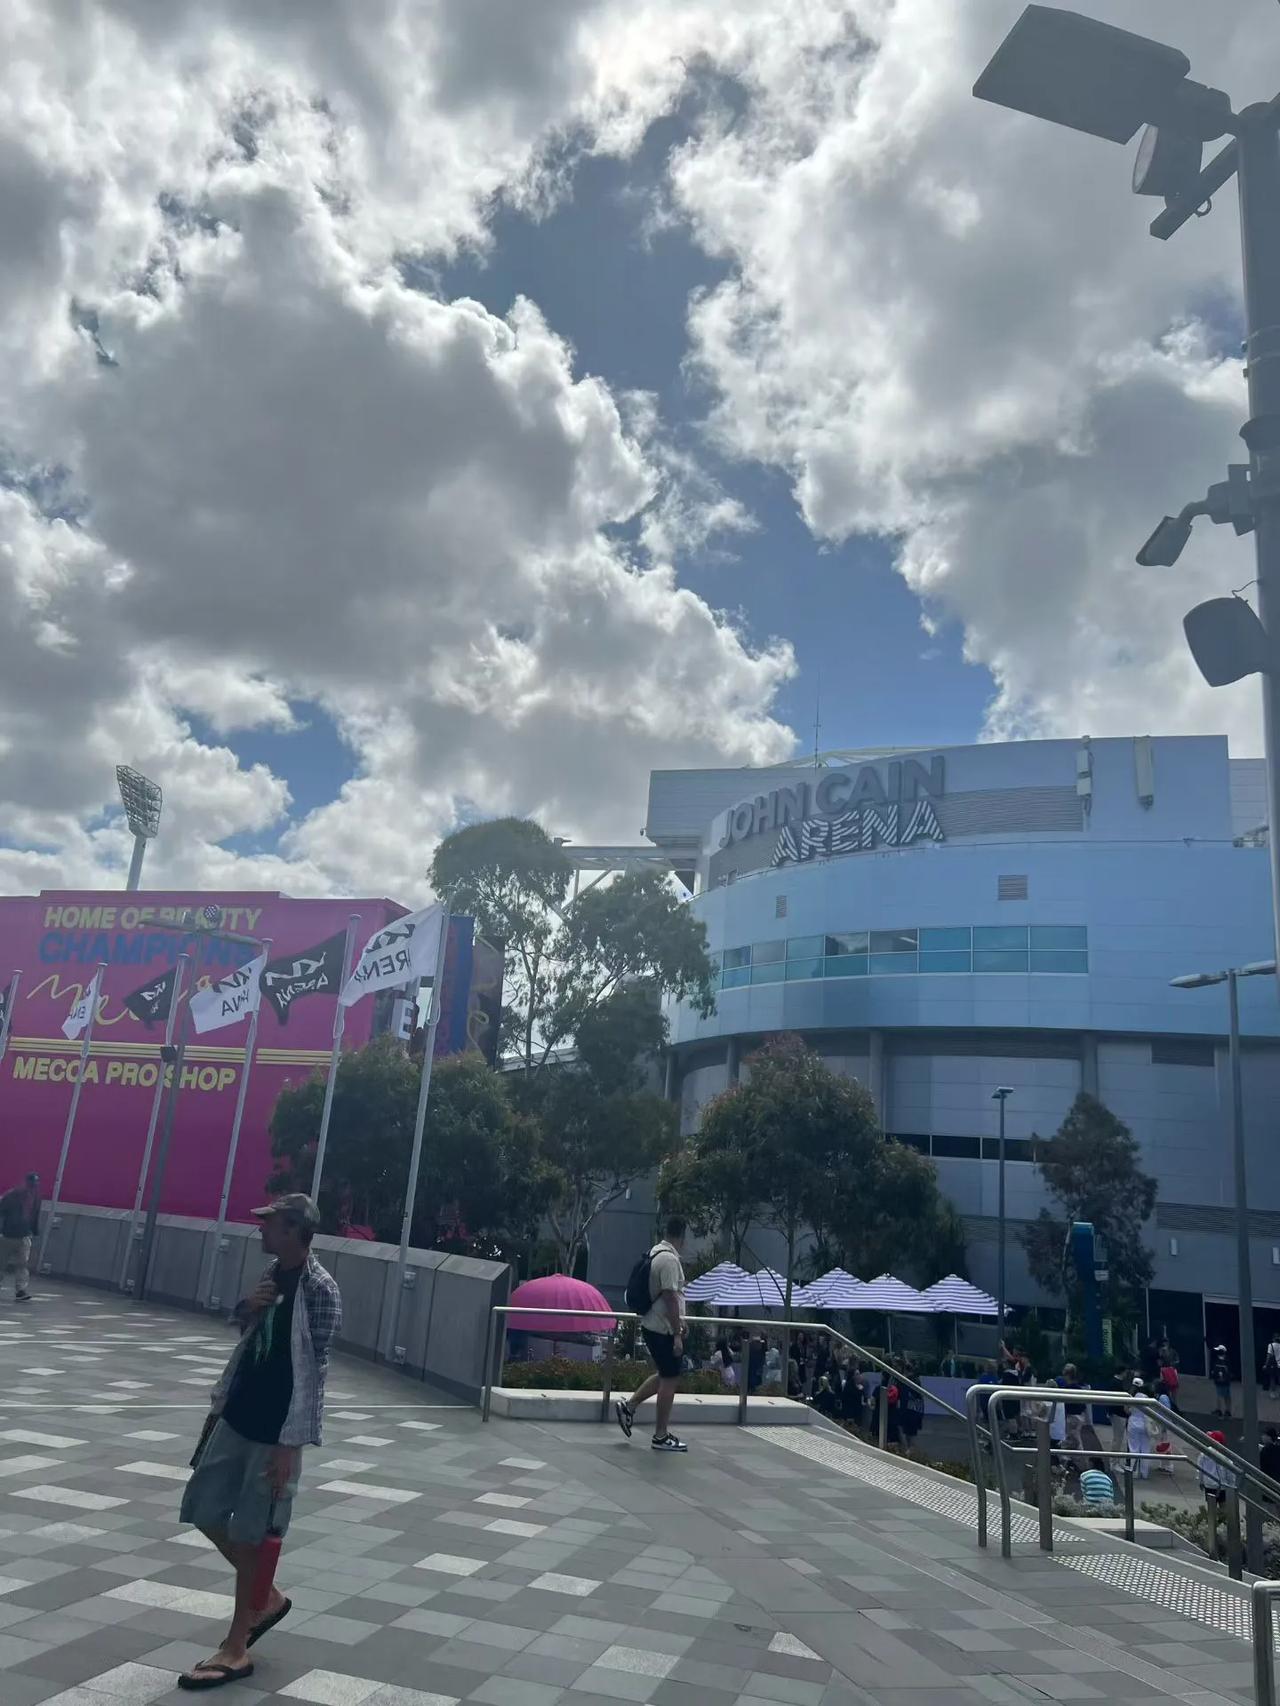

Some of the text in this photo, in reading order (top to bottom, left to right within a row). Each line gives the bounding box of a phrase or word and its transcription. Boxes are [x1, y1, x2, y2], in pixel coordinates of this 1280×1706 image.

[716, 755, 946, 850] JOHN CAIN
[771, 801, 945, 866] ARENA
[43, 906, 117, 929] HOME
[13, 1056, 99, 1084] MECCA
